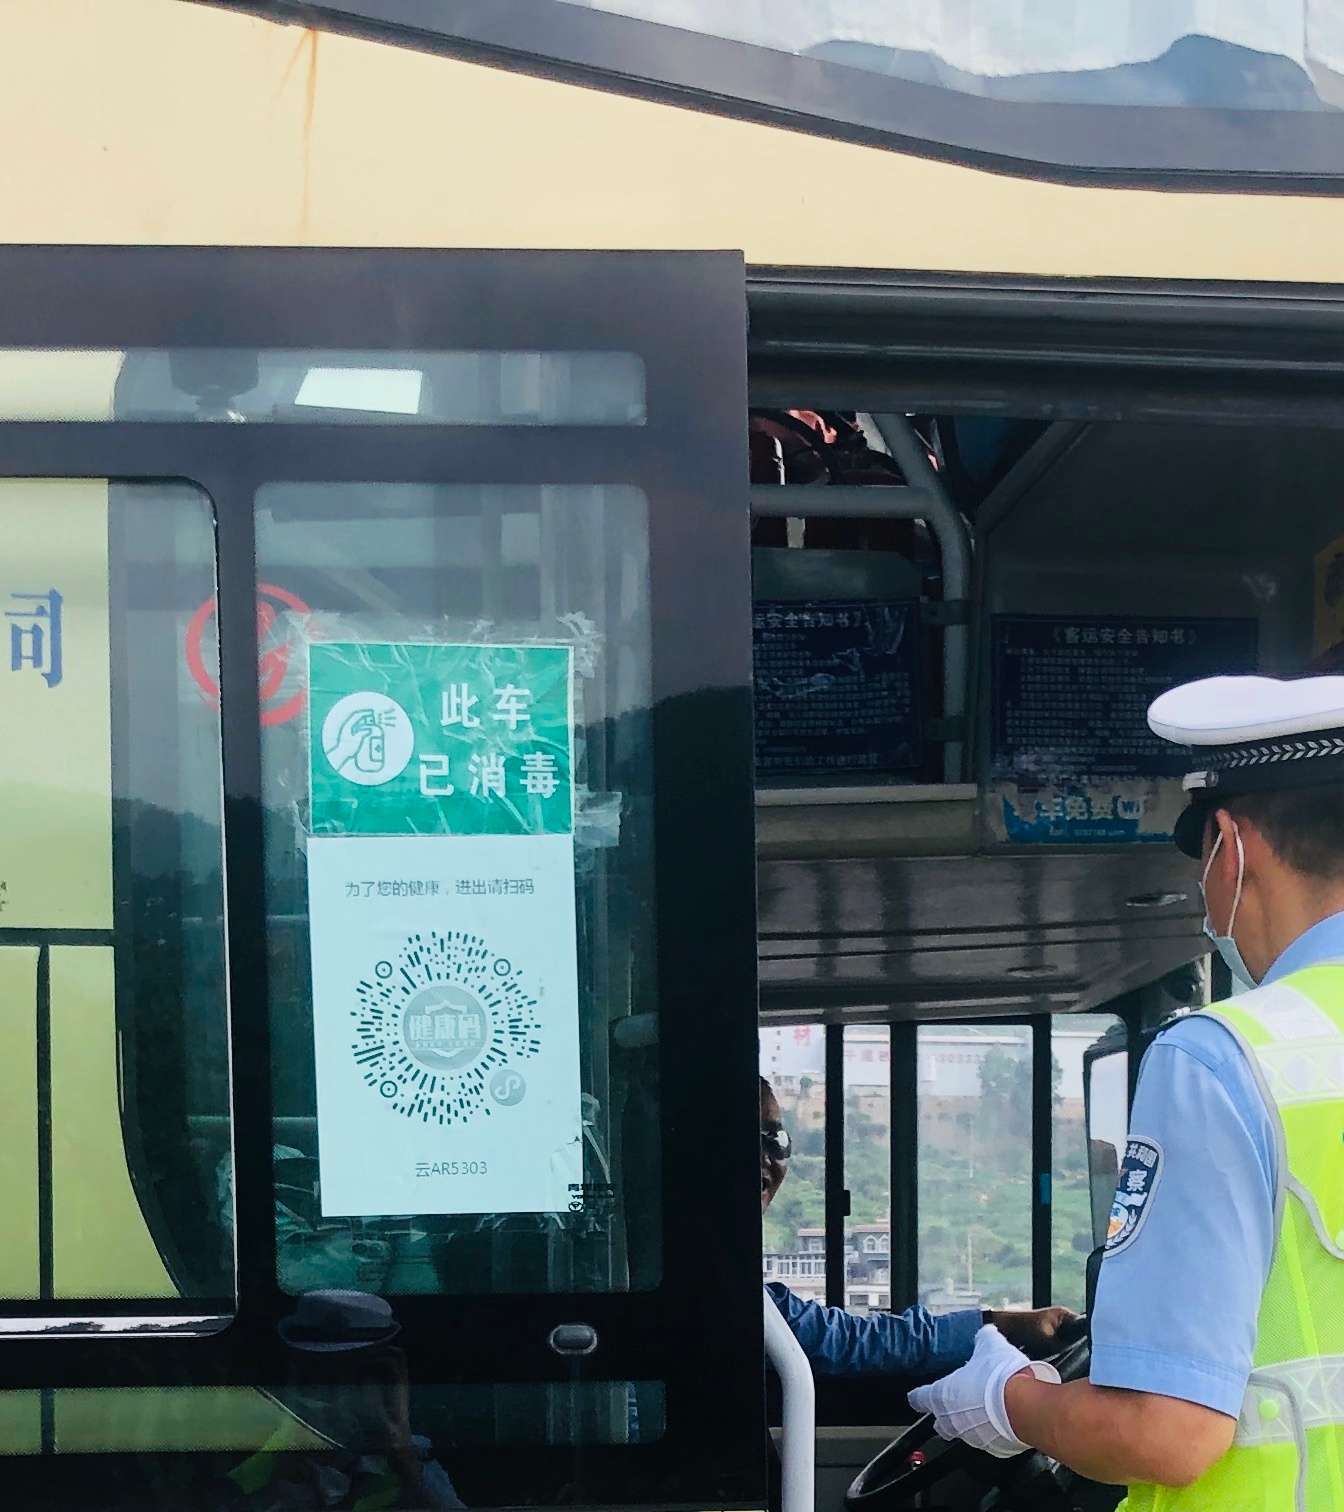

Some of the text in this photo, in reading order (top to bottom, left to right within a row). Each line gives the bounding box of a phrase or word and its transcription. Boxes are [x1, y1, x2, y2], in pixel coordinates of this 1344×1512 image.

[440, 683, 532, 729] 此车
[418, 751, 560, 800] 已消毒
[414, 1161, 489, 1178] 云AR5303
